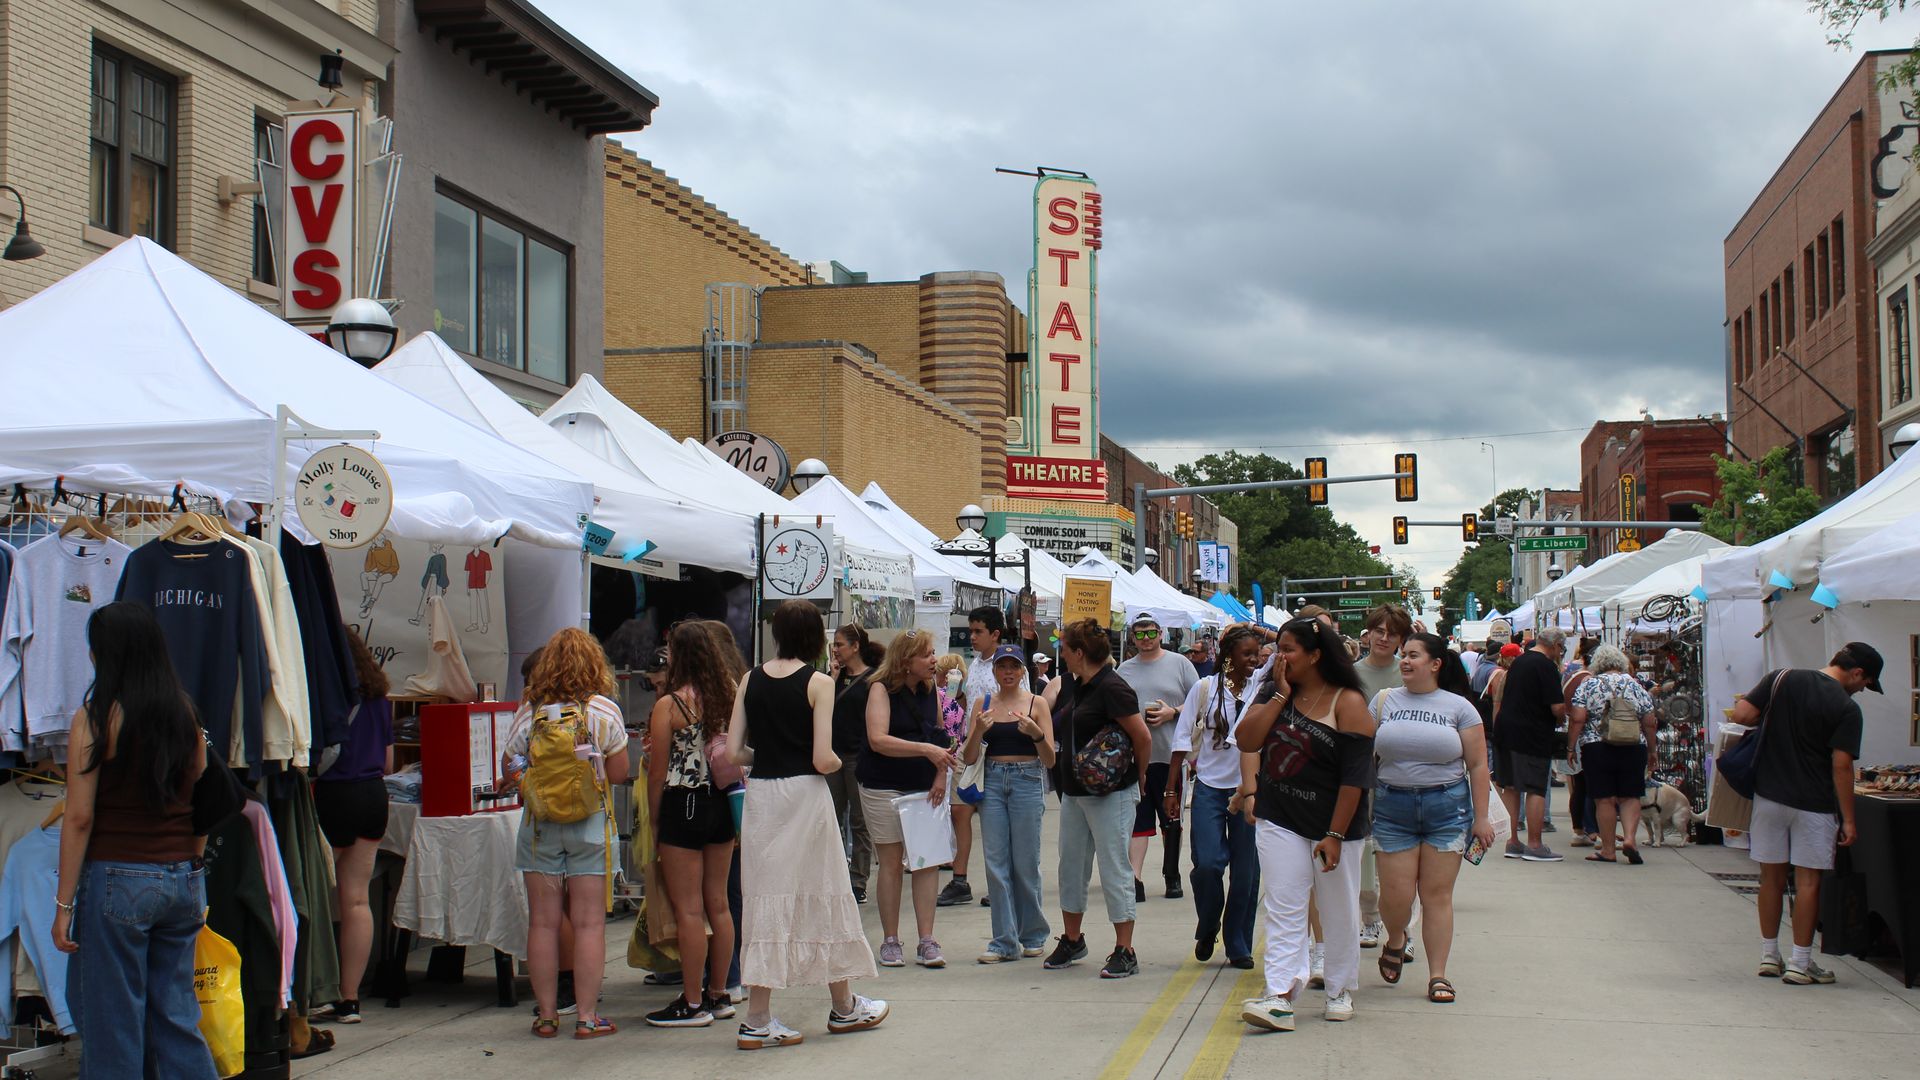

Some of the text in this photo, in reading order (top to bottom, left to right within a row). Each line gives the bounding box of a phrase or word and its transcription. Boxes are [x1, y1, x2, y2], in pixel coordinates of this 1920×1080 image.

[290, 119, 345, 310] CVS
[1047, 196, 1082, 445] STATE
[723, 432, 750, 441] CATERING
[299, 458, 381, 490] Molly Louise
[1012, 463, 1092, 483] THEATRE
[329, 528, 358, 542] Shop
[1024, 525, 1086, 538] COMING SOON
[1045, 539, 1072, 550] AFTER
[1544, 540, 1580, 548] Liberty
[806, 583, 815, 591] SIX
[814, 565, 826, 583] POINT
[1076, 598, 1099, 606] TASTING
[1386, 709, 1449, 728] MICHIGAN
[1305, 724, 1336, 748] STONES
[1279, 783, 1317, 801] US TOUR
